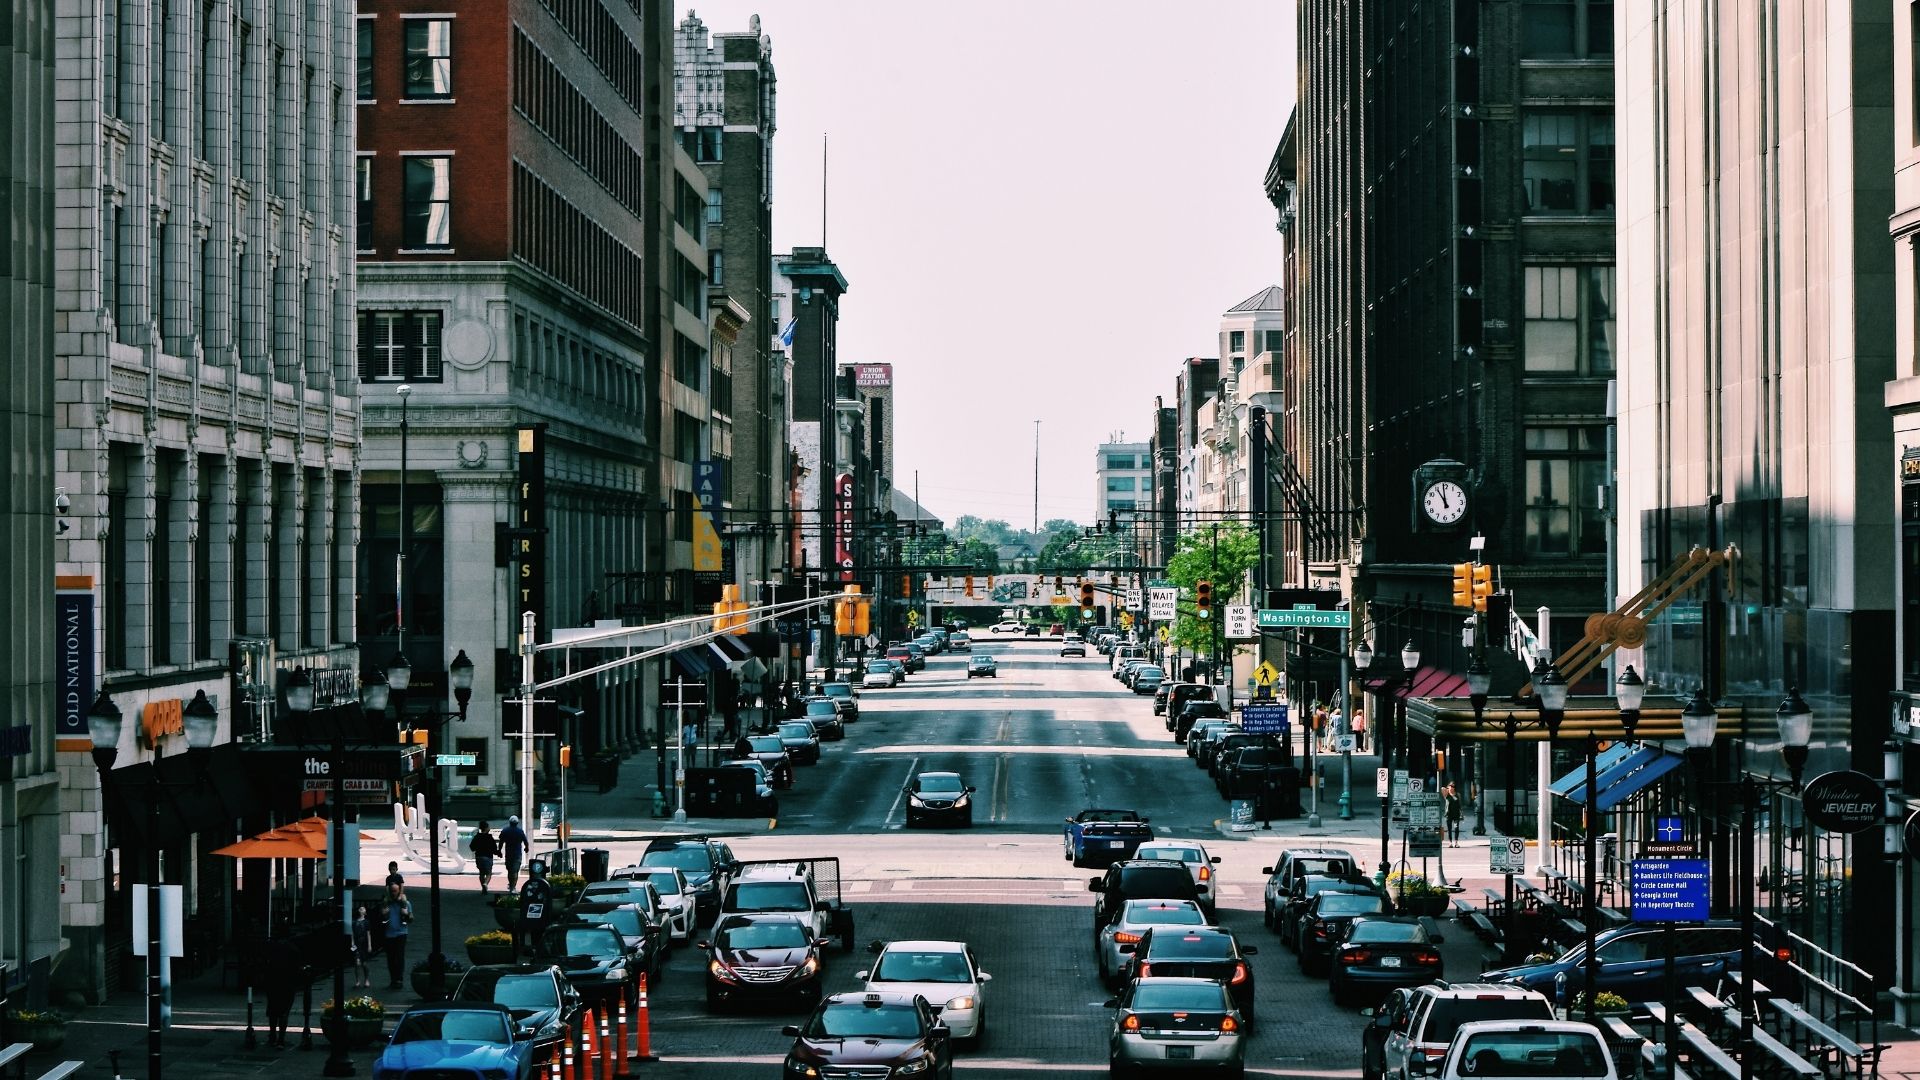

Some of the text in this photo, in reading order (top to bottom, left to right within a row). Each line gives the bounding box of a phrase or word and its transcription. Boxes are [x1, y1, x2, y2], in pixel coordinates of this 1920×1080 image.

[1263, 614, 1346, 624] Washington St
[67, 604, 79, 726] OLD NATIONAL
[442, 756, 464, 764] Court
[304, 757, 330, 774] the
[345, 781, 362, 789] CRAB
[364, 781, 369, 789] &
[370, 781, 384, 789] BAR
[1811, 784, 1860, 800] Windsor
[1822, 803, 1876, 813] JEWELRY
